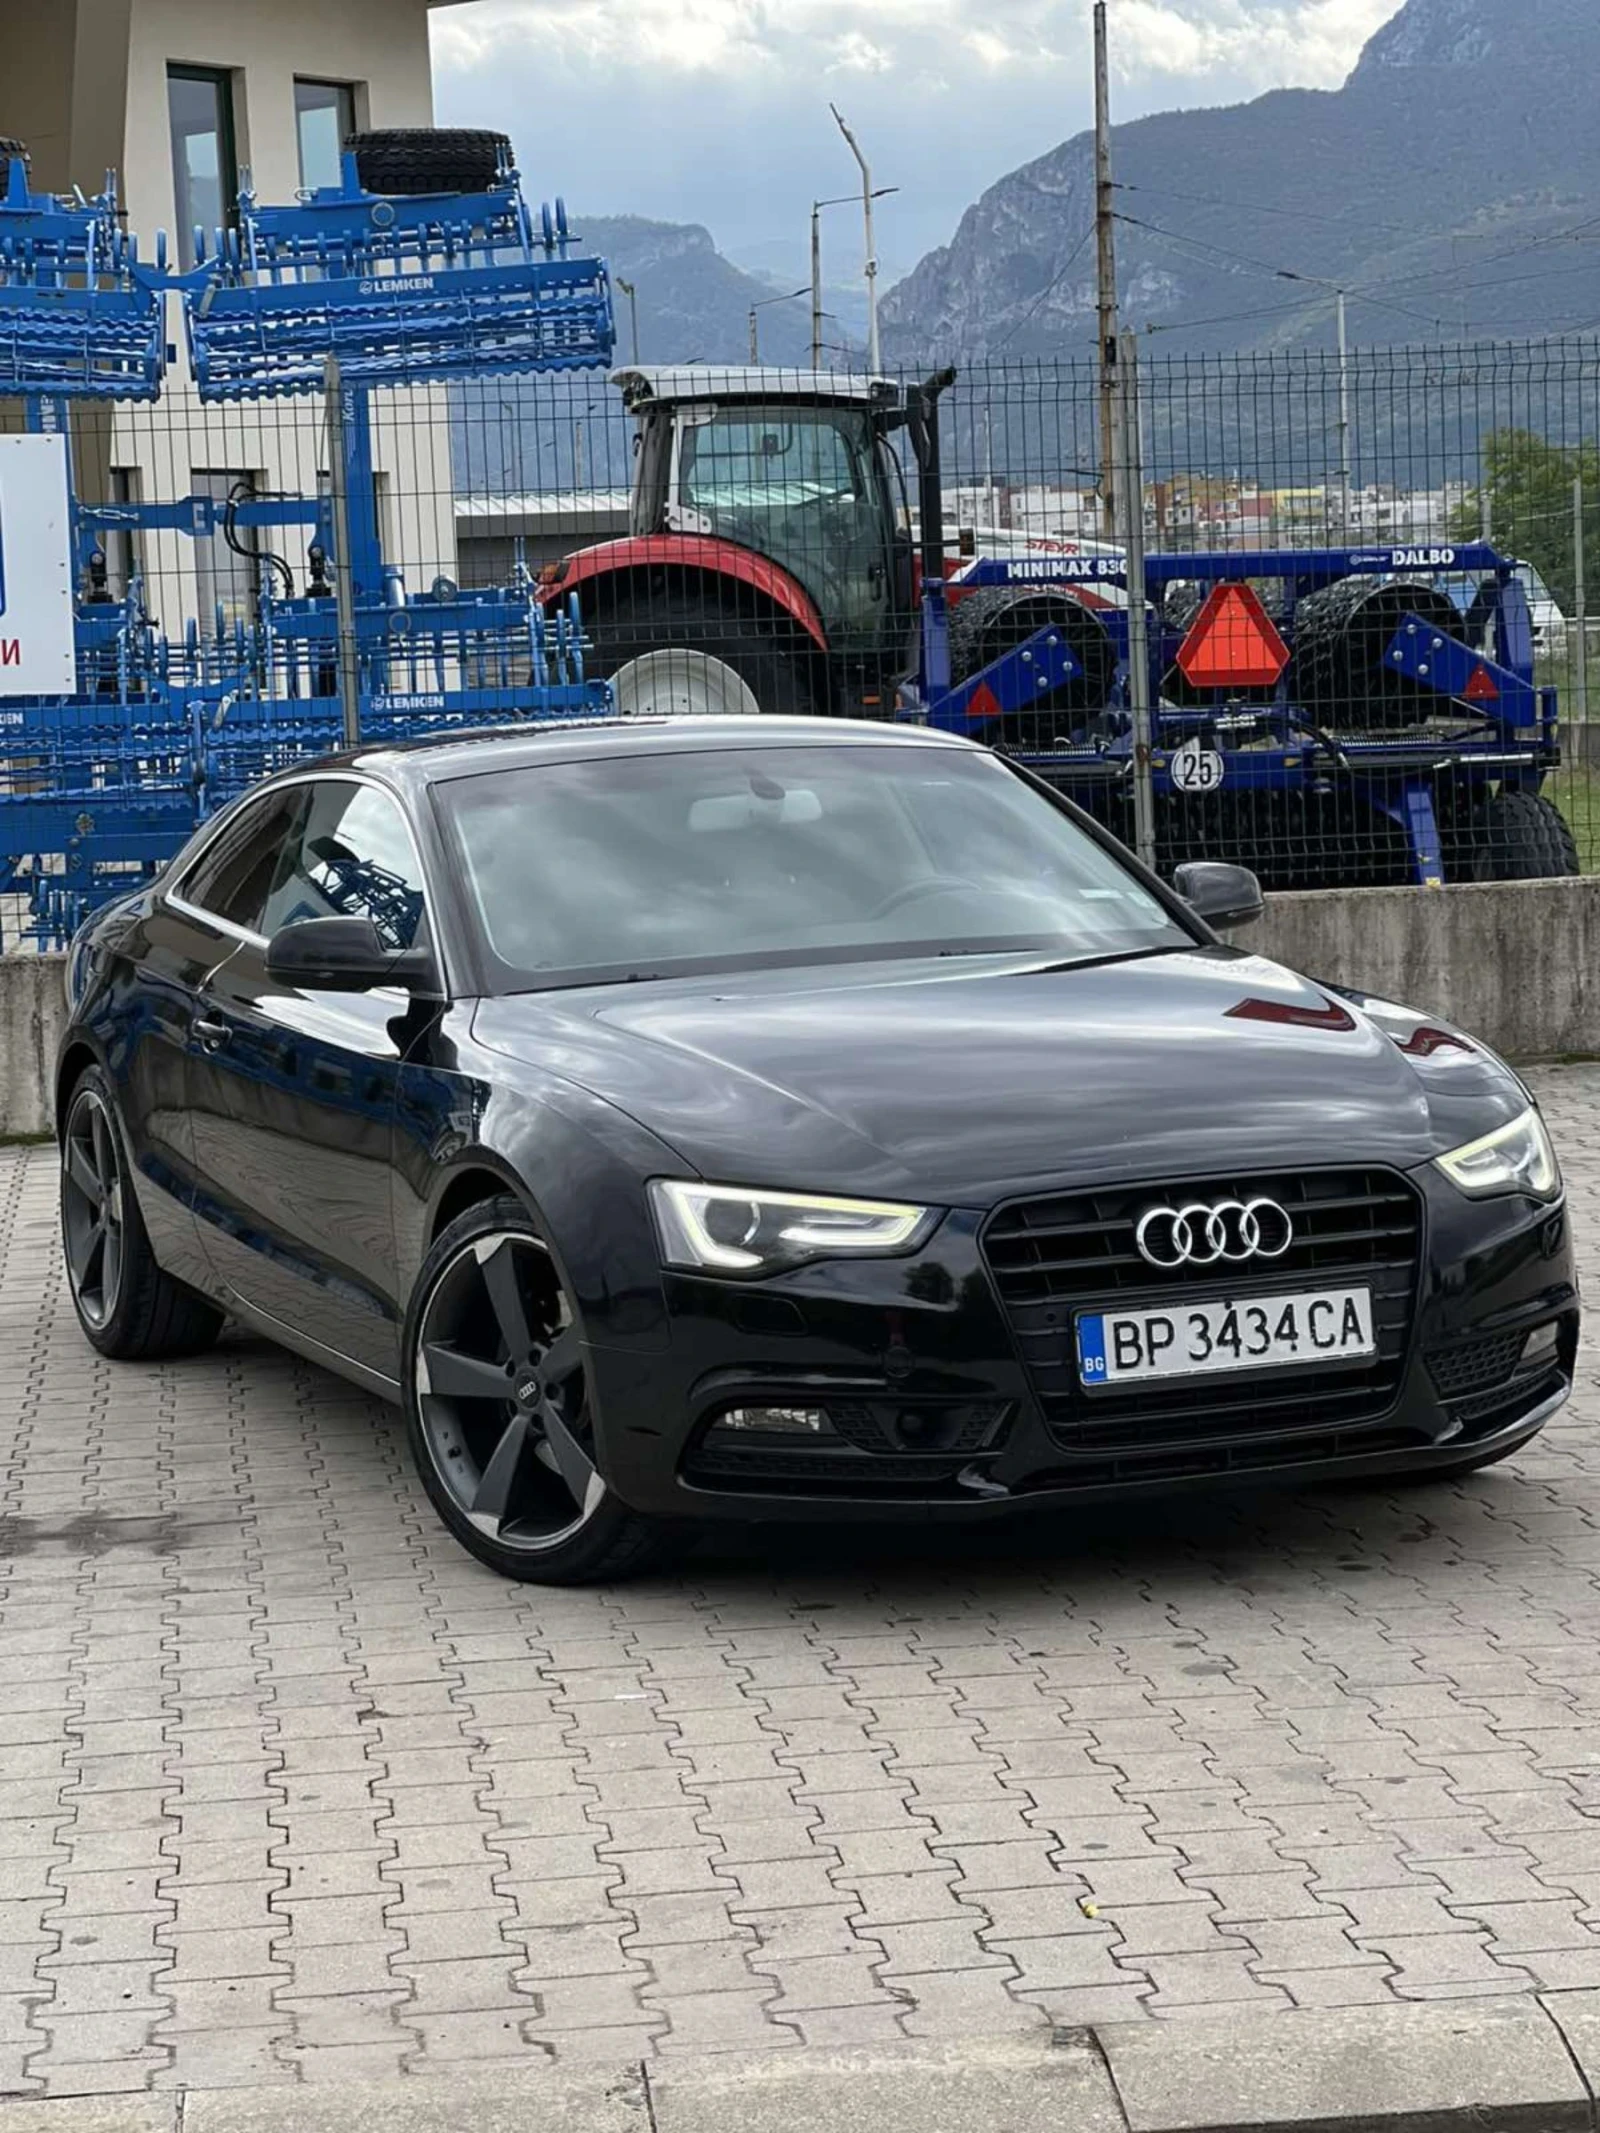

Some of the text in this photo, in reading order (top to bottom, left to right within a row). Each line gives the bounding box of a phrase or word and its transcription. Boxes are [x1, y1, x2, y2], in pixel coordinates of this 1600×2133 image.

[374, 277, 434, 293] LEMKEN
[1024, 540, 1079, 555] STEYR
[1392, 548, 1455, 565] DALBO
[1007, 560, 1093, 578] MINIMAX
[385, 695, 445, 711] LEMKEN
[1184, 753, 1212, 786] 25
[1113, 1296, 1365, 1370] BP 3434 CA
[1084, 1356, 1105, 1373] BG
